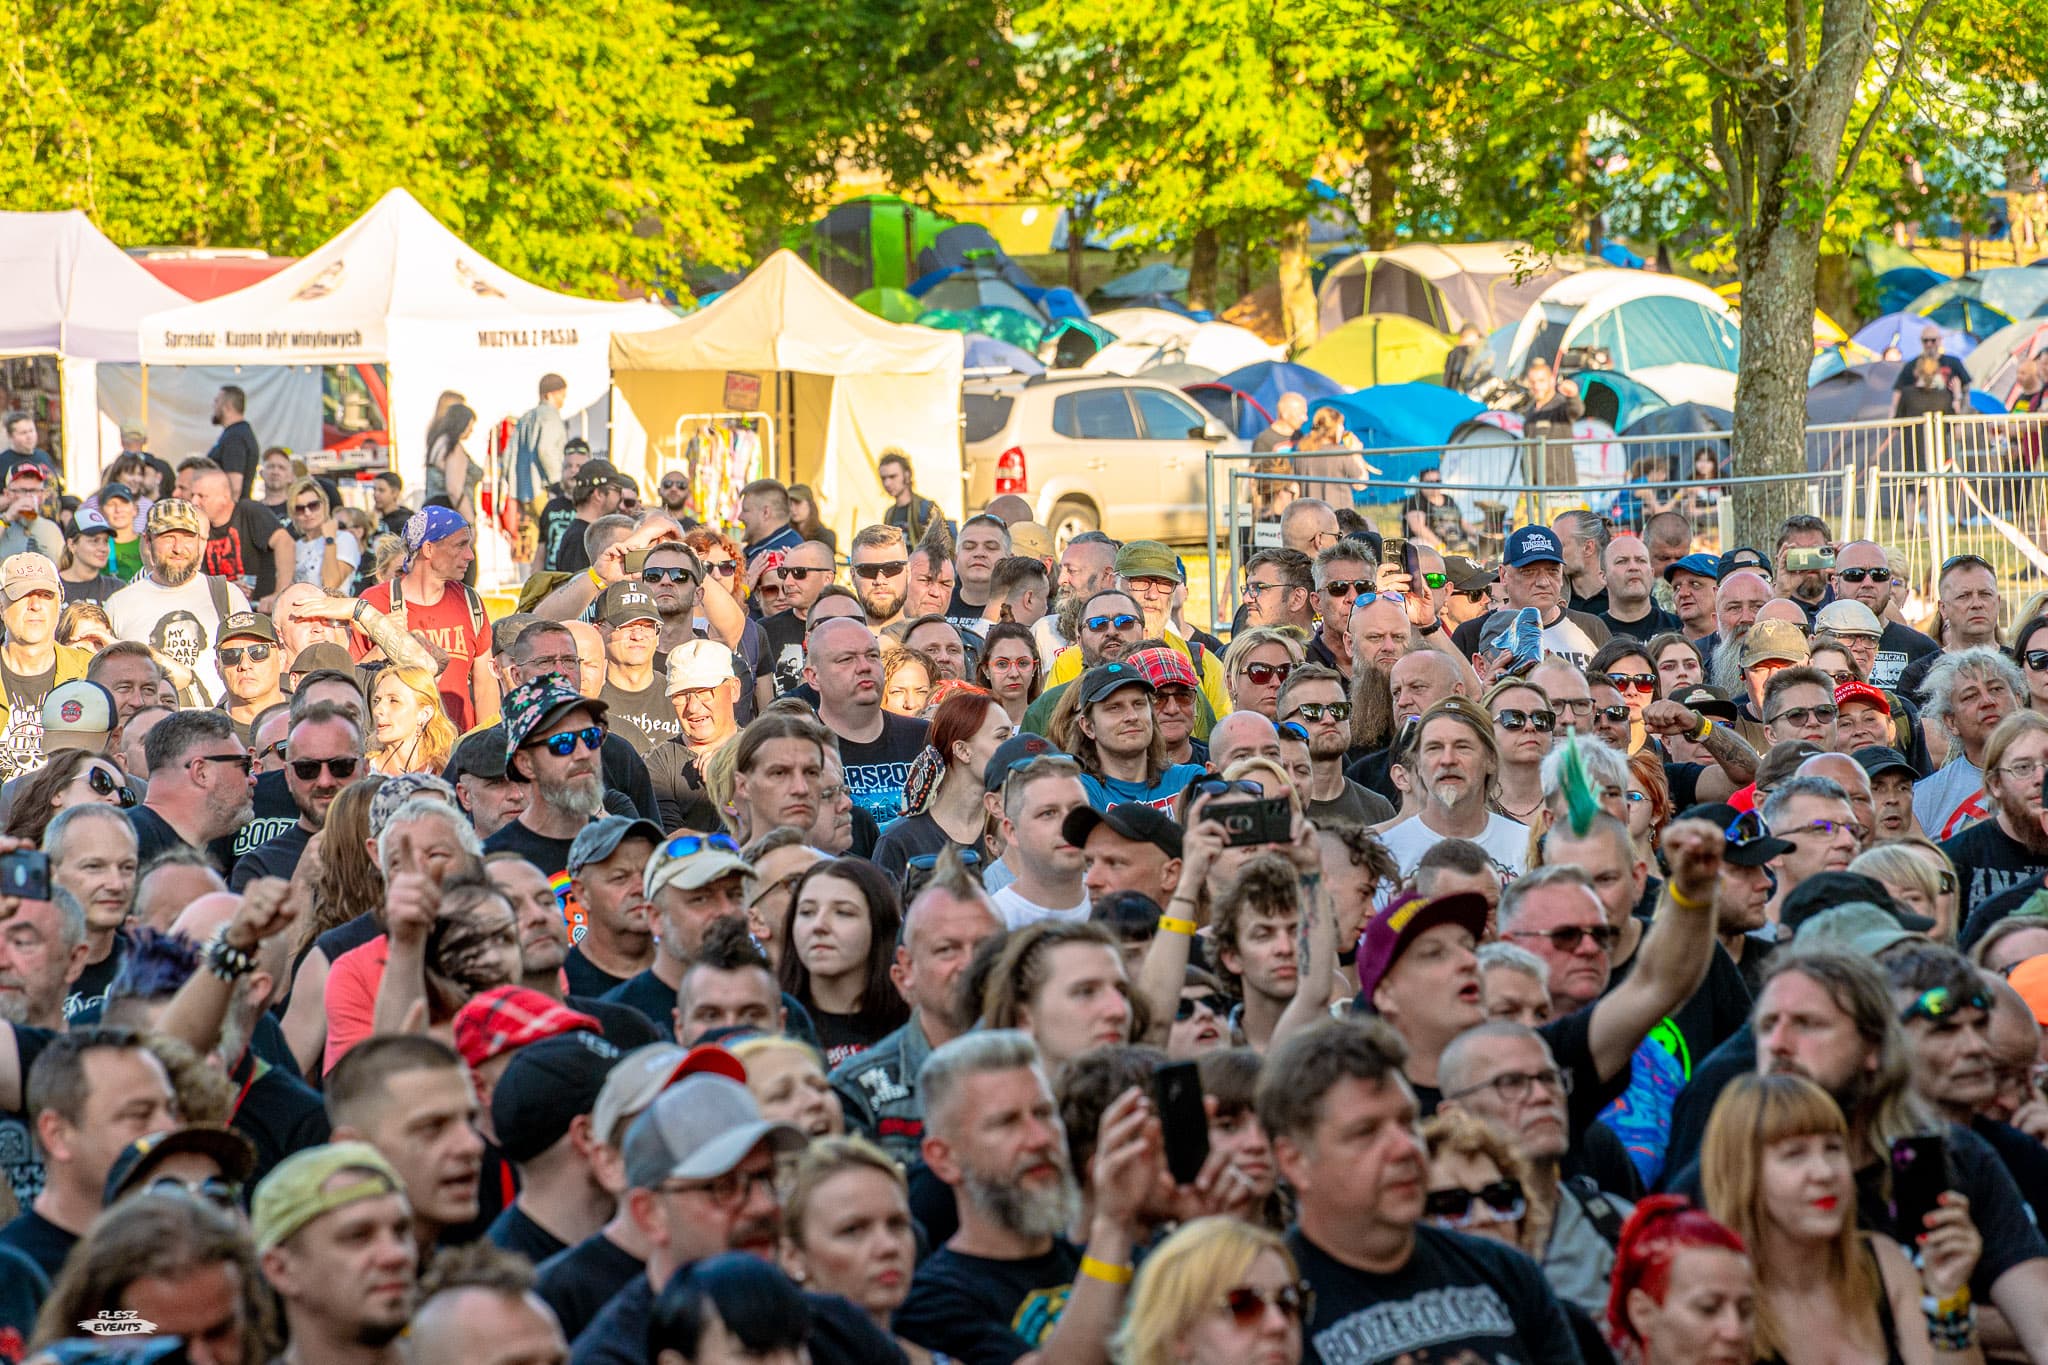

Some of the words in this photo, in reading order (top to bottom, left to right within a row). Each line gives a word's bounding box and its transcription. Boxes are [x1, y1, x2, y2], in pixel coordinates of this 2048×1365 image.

[478, 330, 529, 347] MUZYKA
[168, 628, 185, 639] MY
[167, 639, 199, 649] IDOLS
[175, 648, 198, 658] ARE
[843, 763, 911, 789] ASPO
[851, 787, 868, 796] TAL
